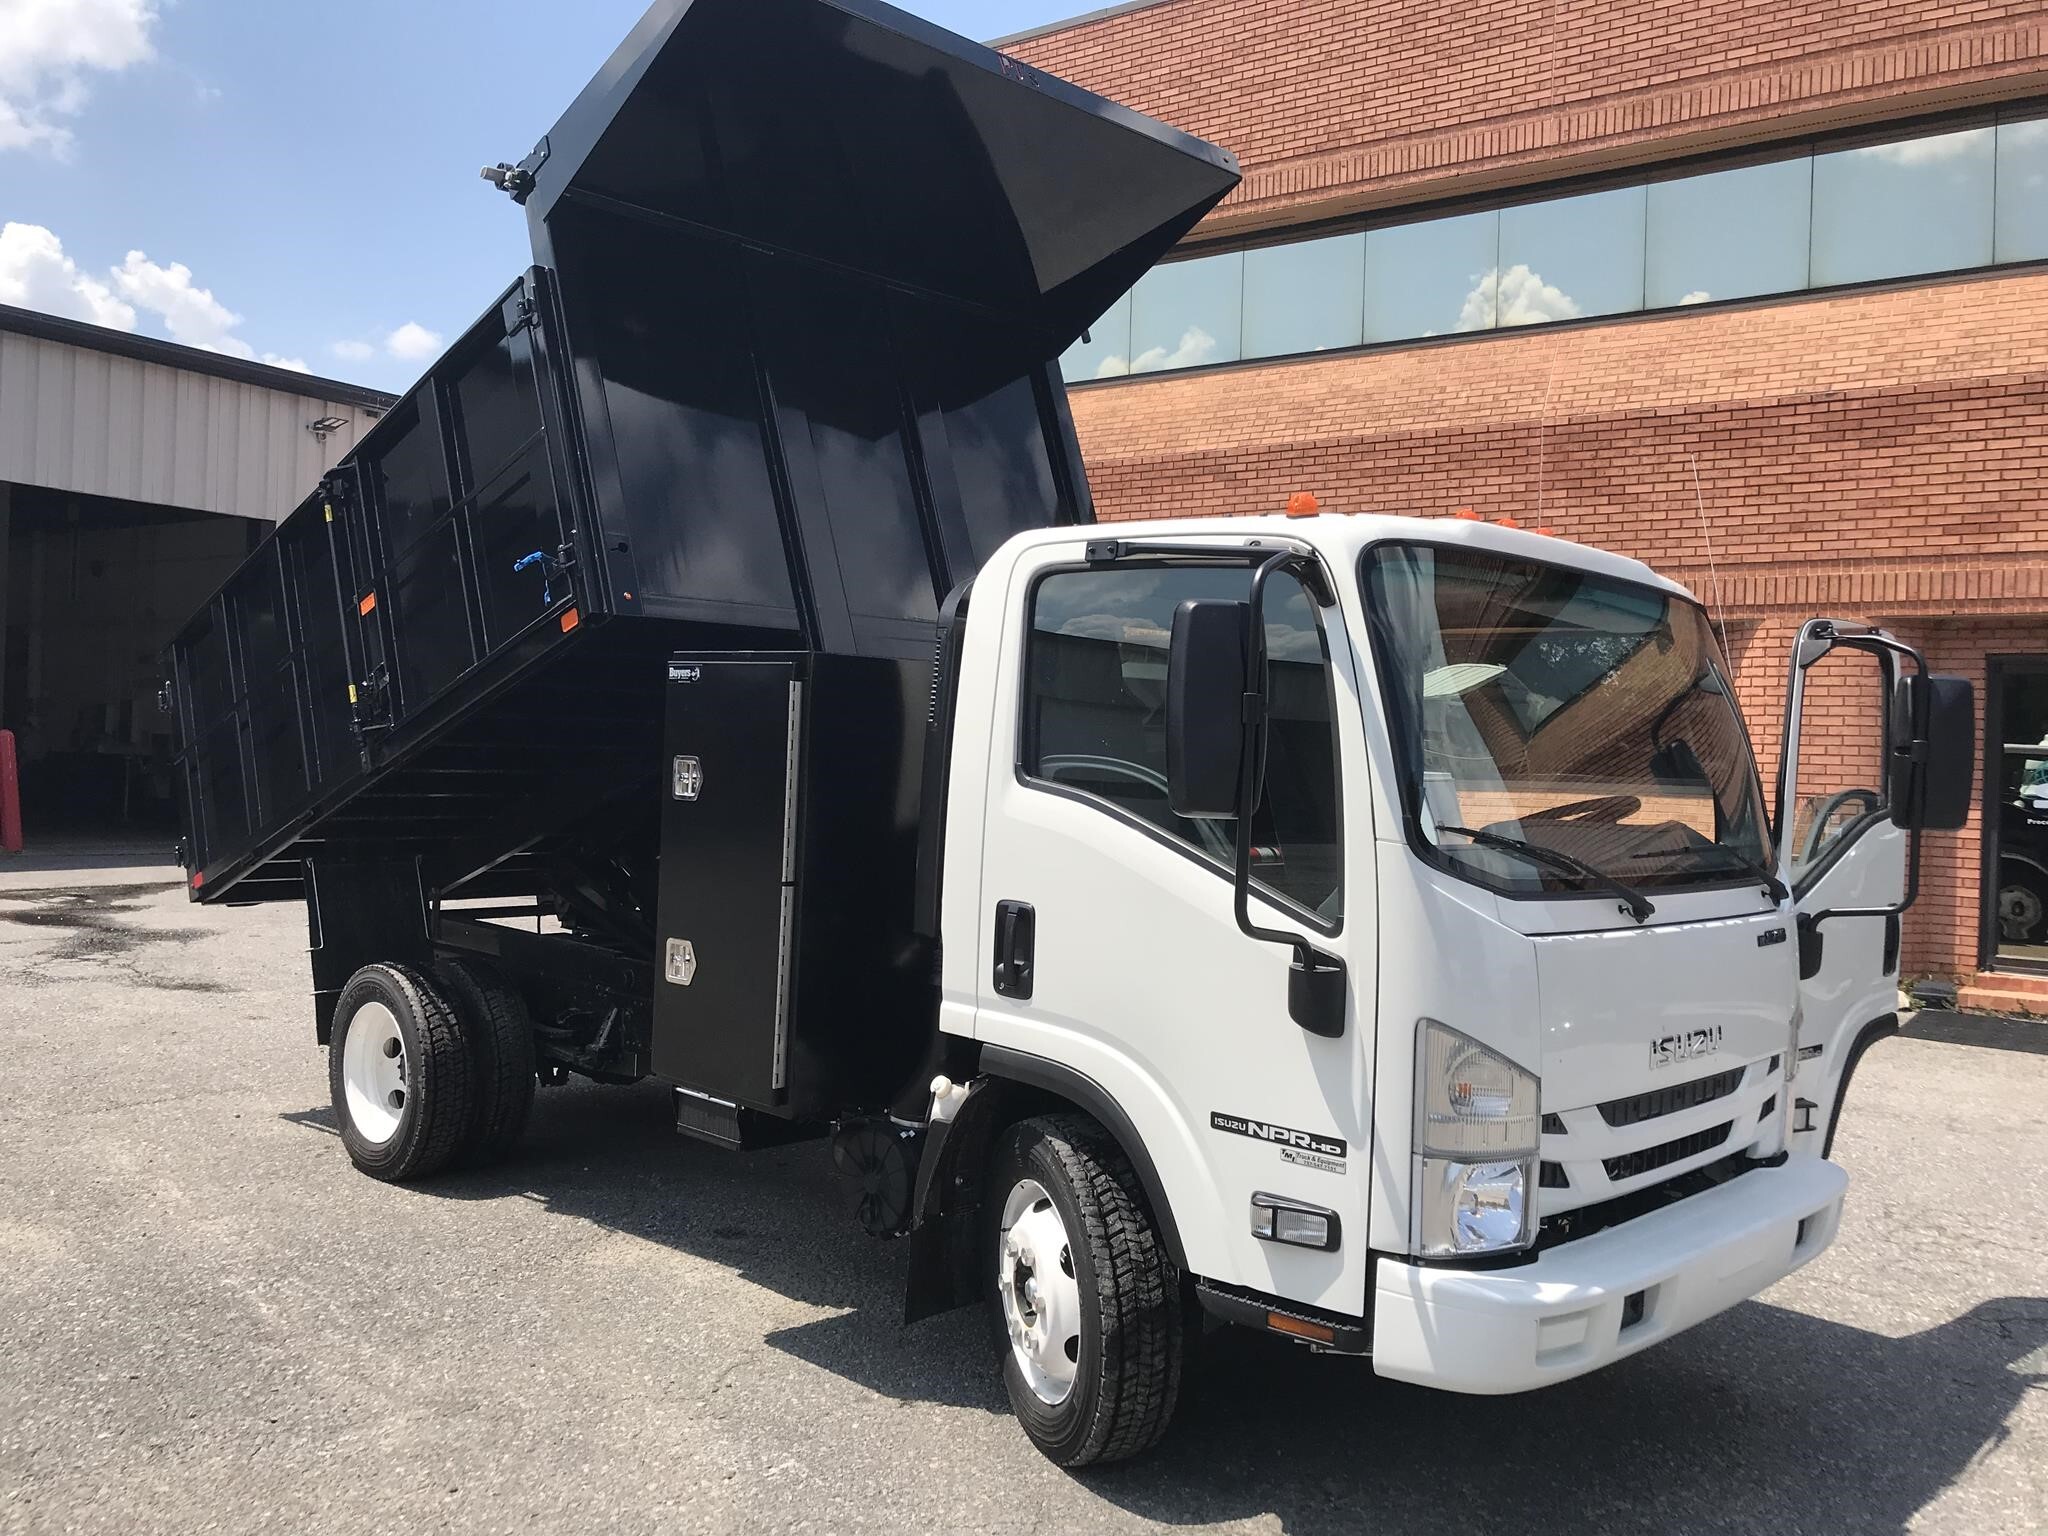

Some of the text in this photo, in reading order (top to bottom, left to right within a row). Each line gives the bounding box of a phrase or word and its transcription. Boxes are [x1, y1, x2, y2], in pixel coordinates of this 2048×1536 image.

[669, 667, 691, 679] Buyers
[1649, 1024, 1722, 1070] ISUZU
[1215, 1116, 1246, 1131] ISUZU
[1296, 1152, 1310, 1161] Truck
[1316, 1156, 1345, 1168] Equipment
